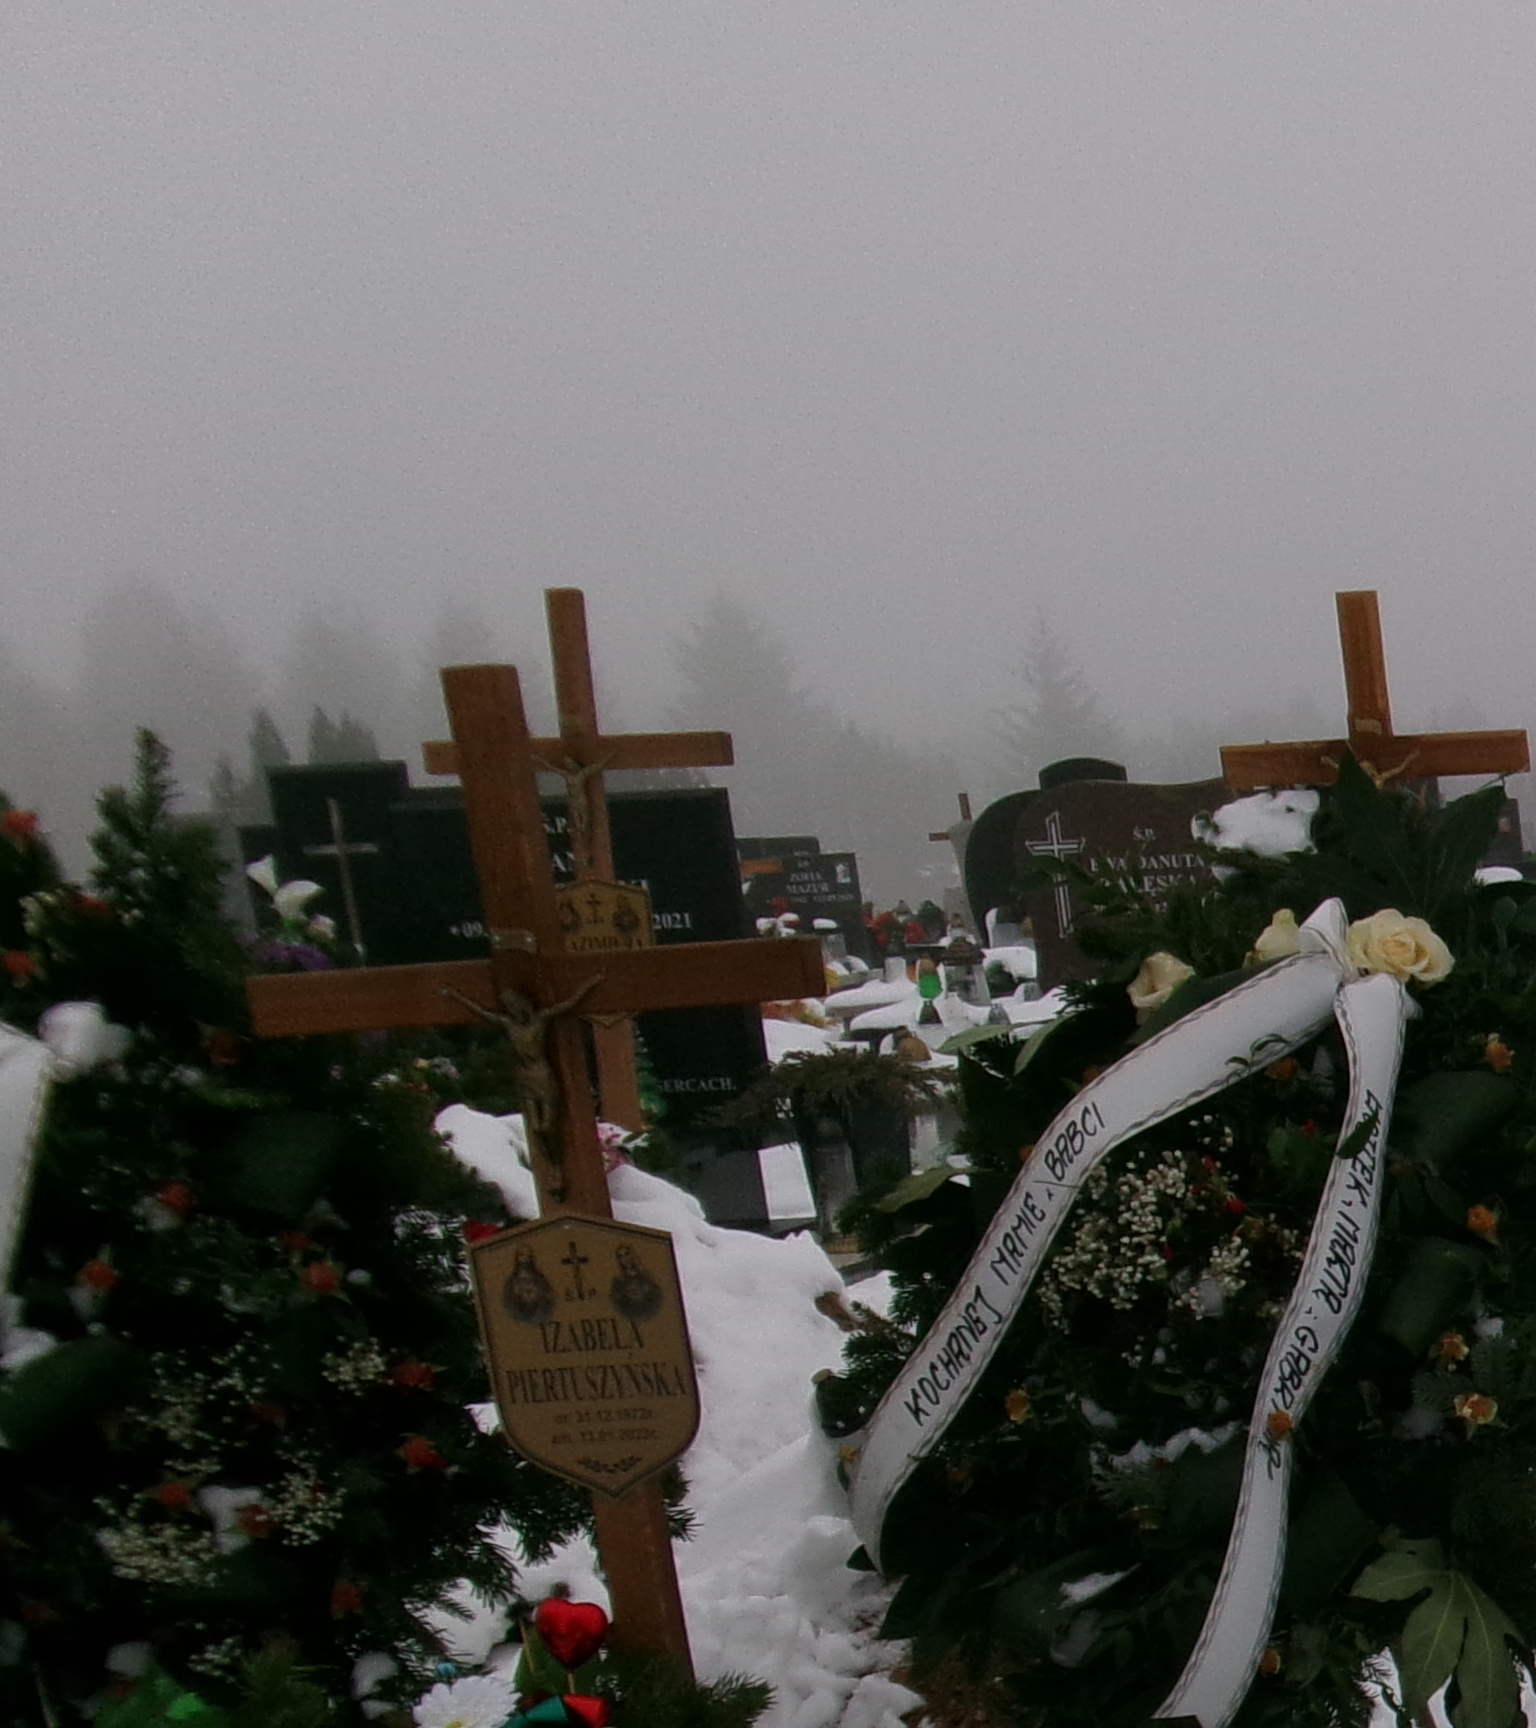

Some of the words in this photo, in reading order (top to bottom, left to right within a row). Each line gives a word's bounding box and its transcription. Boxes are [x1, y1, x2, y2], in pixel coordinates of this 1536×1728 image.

[542, 1318, 644, 1352] IZABELA
[904, 1284, 1002, 1427] KOCHANEJ
[990, 1191, 1047, 1286] MAMIE
[1043, 1102, 1106, 1183] BABCI
